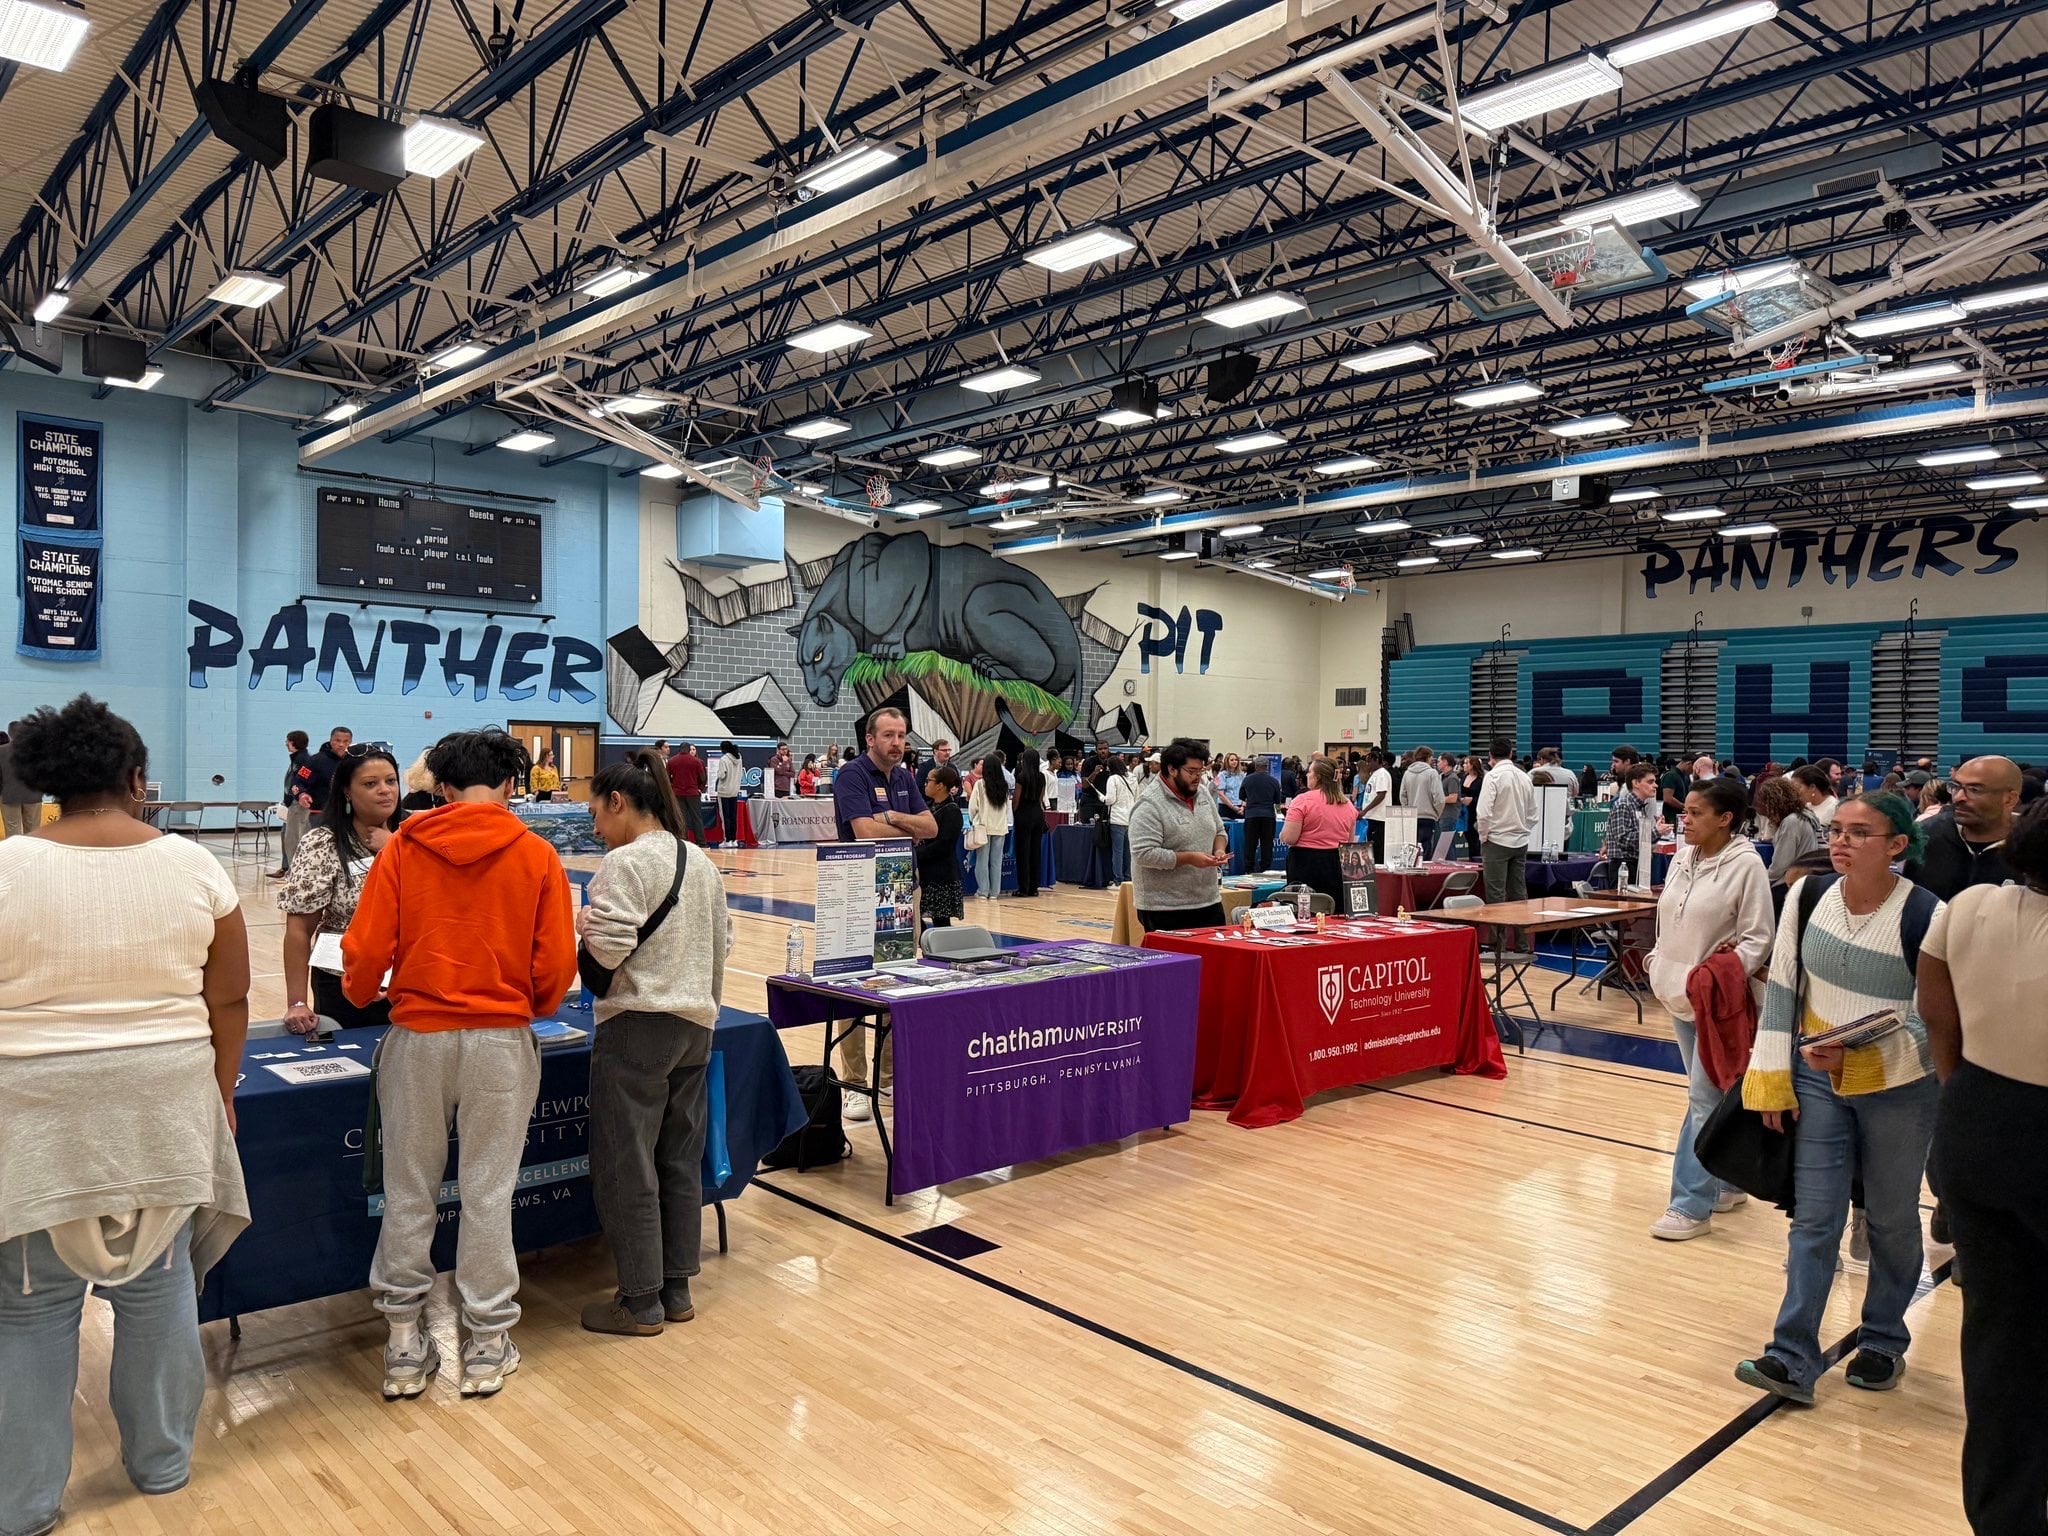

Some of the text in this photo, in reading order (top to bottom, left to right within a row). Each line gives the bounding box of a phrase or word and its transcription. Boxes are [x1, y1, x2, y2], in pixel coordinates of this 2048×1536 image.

[45, 431, 79, 445] STATE
[30, 439, 92, 456] CHAMPIONS
[42, 456, 79, 468] POTOMAC
[33, 463, 87, 476] HIGH SCHOOL
[378, 497, 400, 509] Home
[469, 509, 494, 520] Guests
[424, 535, 448, 545] period
[376, 543, 395, 554] fouls
[424, 549, 448, 559] player
[1636, 508, 2039, 598] PANTHERS
[42, 550, 80, 564] STATE
[476, 554, 494, 564] fouls
[30, 559, 91, 576] CHAMPIONS
[27, 576, 92, 589] POTOMAC SENIOR
[426, 581, 446, 590] game
[33, 585, 88, 596] HIGH SCHOOL
[478, 586, 493, 594] won
[1137, 602, 1223, 675] PIT
[188, 599, 603, 704] PANTHER
[782, 816, 820, 826] ROANOKE
[1348, 956, 1431, 993] CAPITOL
[1350, 986, 1430, 1010] Technology University
[1309, 1026, 1441, 1062] 1.800.950.1992 admissions@captechu.edu
[966, 1056, 1141, 1097] PITTSBURGH, PENNSYLVANIA
[511, 1188, 571, 1210] EWS, VA
